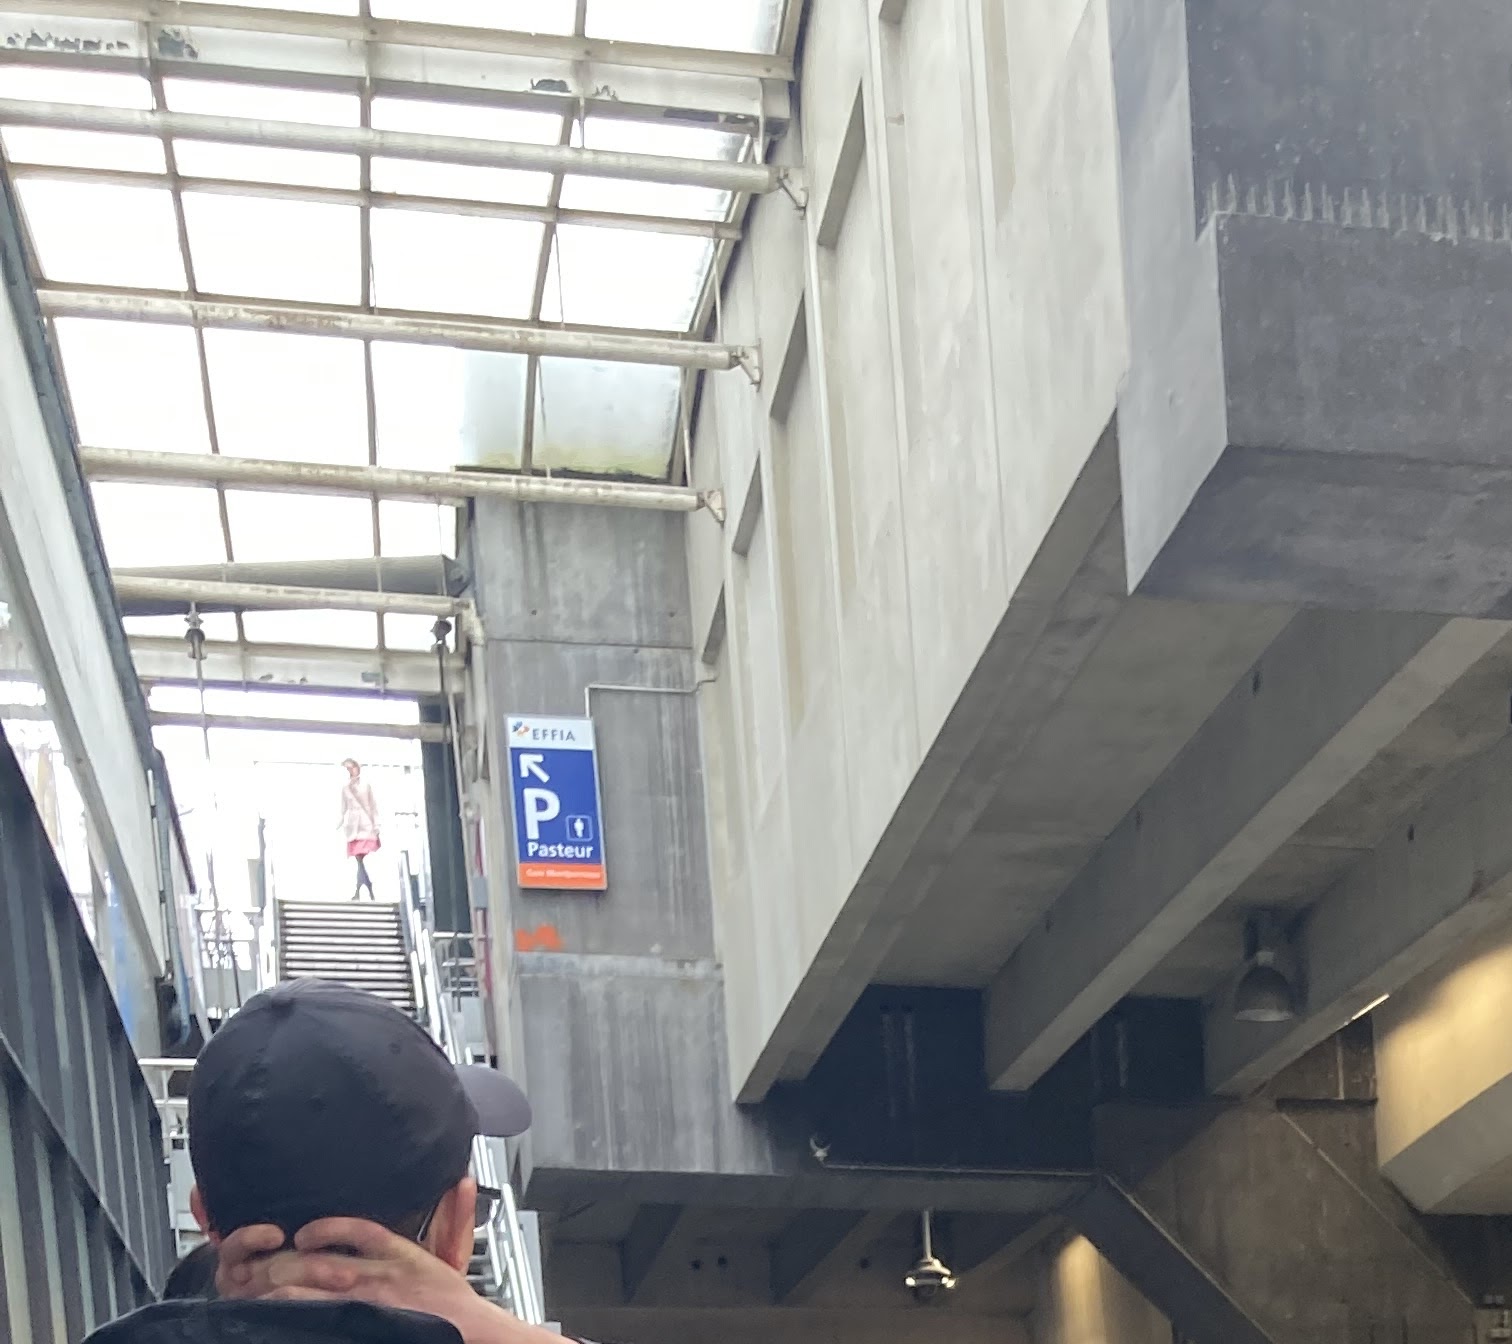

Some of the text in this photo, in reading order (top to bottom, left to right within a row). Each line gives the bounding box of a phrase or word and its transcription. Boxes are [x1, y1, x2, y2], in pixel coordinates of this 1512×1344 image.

[532, 728, 576, 742] EFFIA
[523, 787, 560, 840] P
[527, 841, 594, 860] Pasteur
